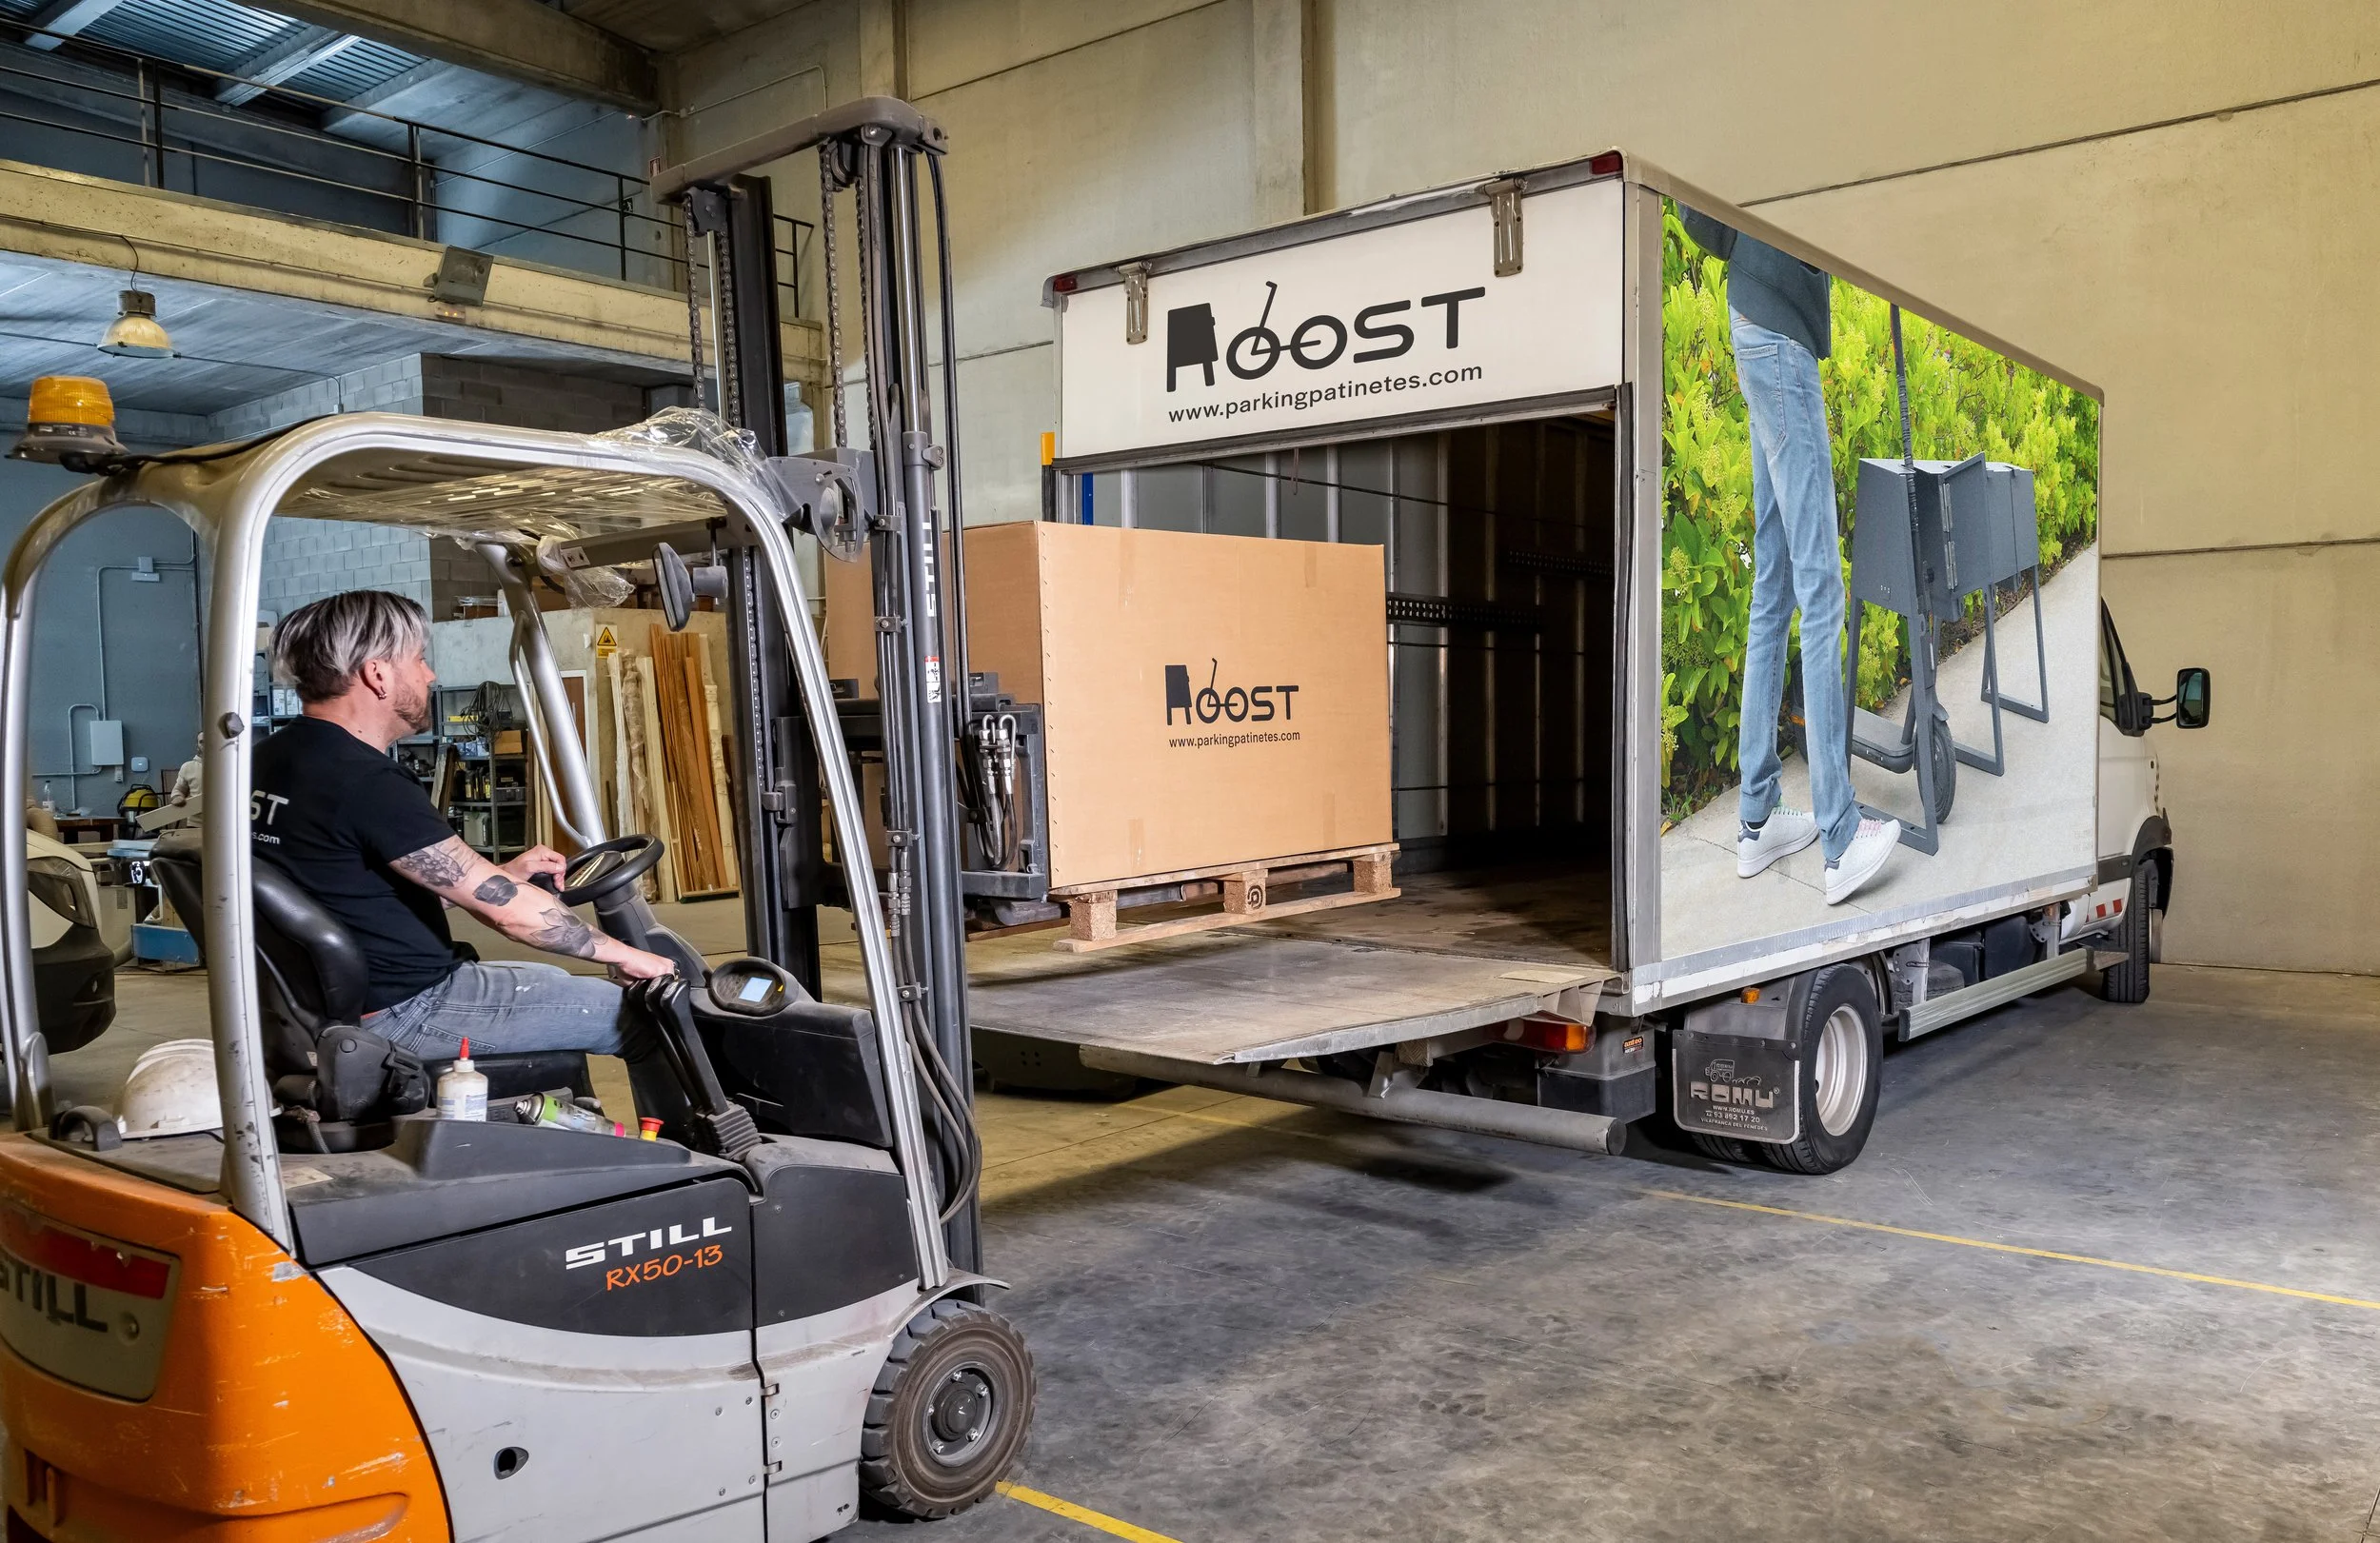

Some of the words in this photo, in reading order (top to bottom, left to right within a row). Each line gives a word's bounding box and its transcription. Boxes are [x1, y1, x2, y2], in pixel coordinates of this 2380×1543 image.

[1166, 281, 1486, 392] ROOST
[1168, 366, 1483, 423] www.parkingpatinetes.com
[1164, 658, 1299, 726] ROOST
[1168, 731, 1300, 749] www.parkingpatinetes.com
[1690, 1081, 1774, 1108] ROMU
[565, 1217, 732, 1270] STILL
[605, 1244, 724, 1291] RX50-13
